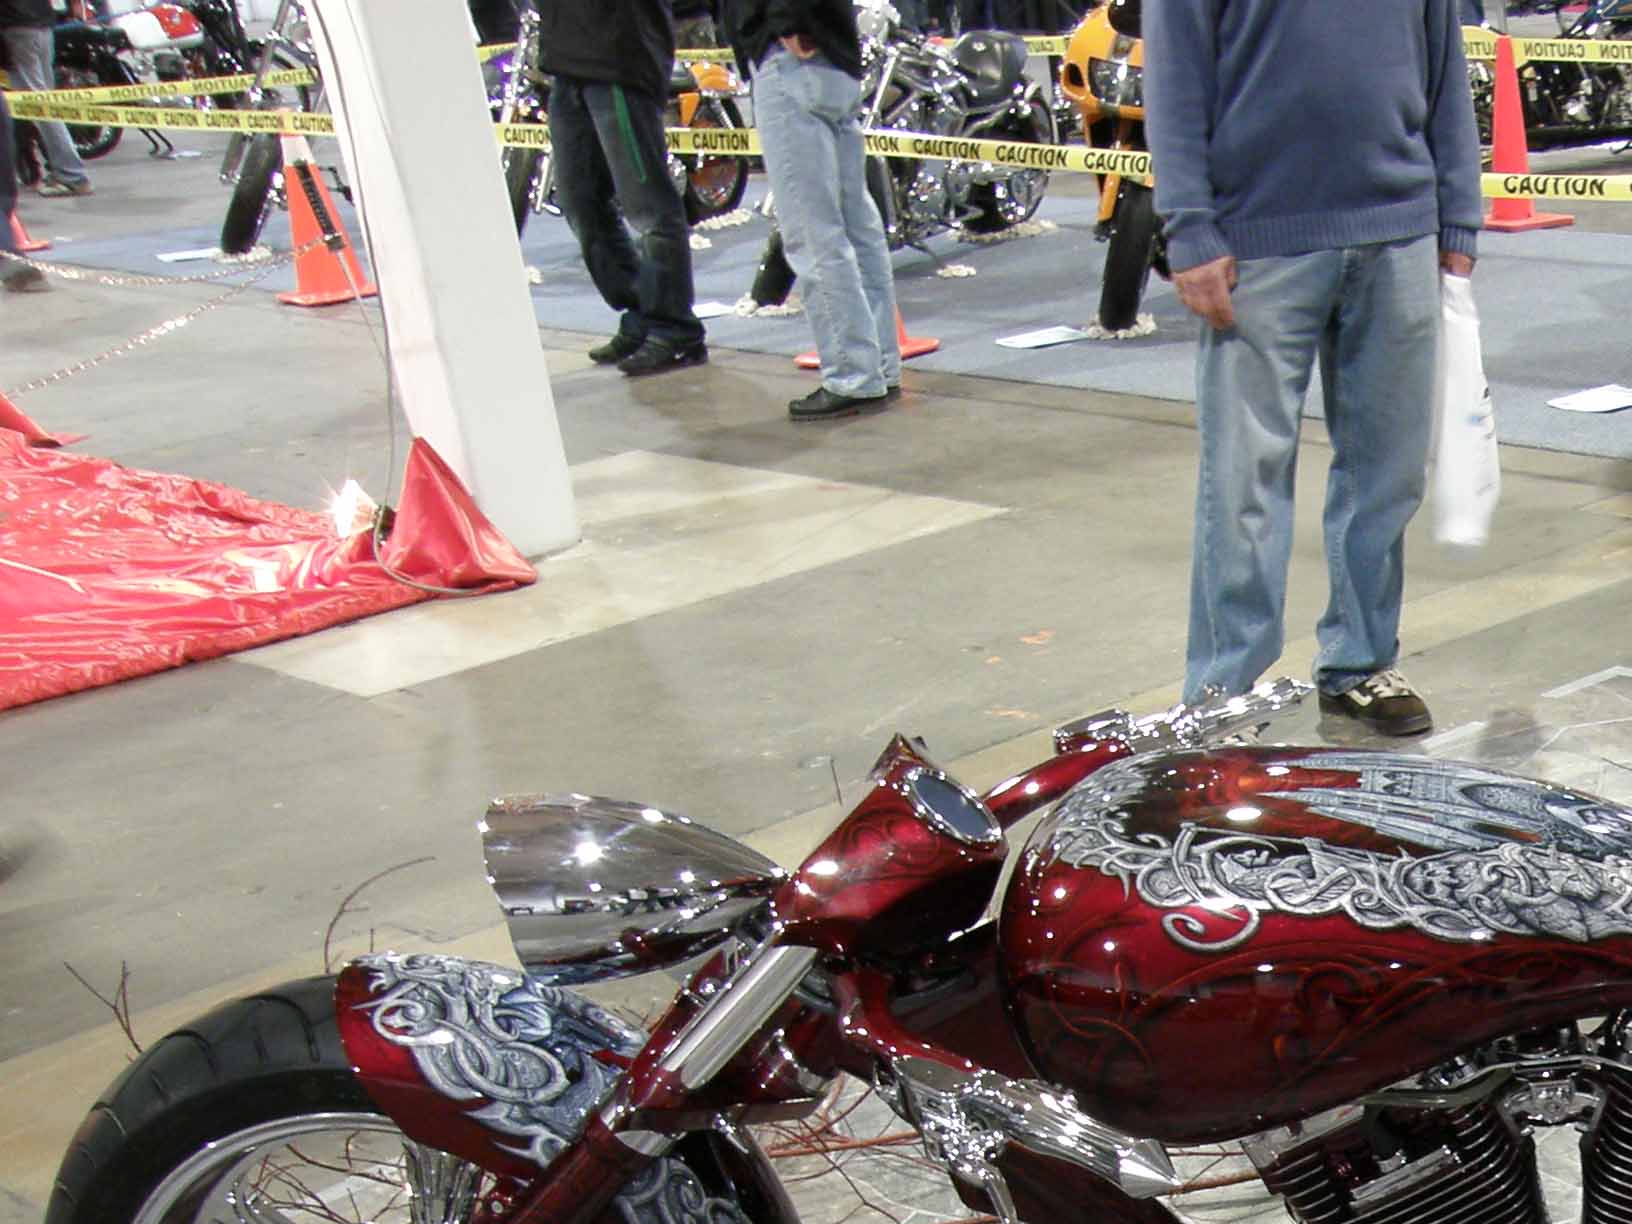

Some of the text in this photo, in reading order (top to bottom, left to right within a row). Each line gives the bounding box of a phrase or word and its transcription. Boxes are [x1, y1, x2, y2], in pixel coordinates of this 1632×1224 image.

[293, 116, 334, 132] CAUTION
[692, 133, 749, 151] CAUTION
[865, 134, 900, 152] TION
[912, 138, 981, 160] CAUTION
[995, 144, 1068, 167] CAUTION
[1503, 176, 1607, 196] CAUTION
